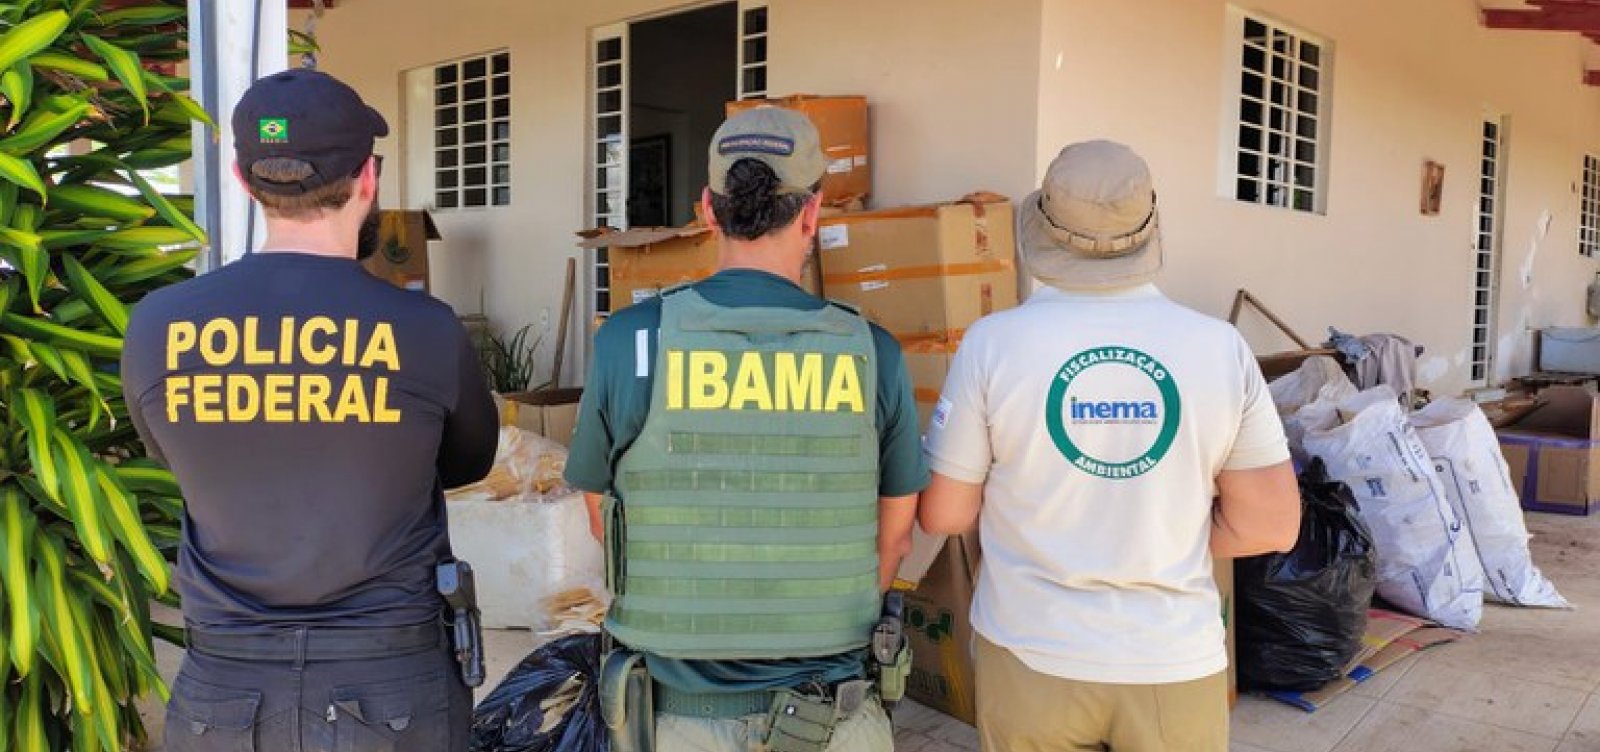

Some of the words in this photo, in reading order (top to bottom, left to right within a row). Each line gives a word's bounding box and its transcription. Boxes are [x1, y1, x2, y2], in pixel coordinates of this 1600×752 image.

[166, 316, 400, 370] POLICIA
[166, 374, 400, 422] FEDERAL
[666, 350, 865, 412] IBAMA
[1070, 396, 1158, 419] inema
[1075, 456, 1157, 477] AMBIENTAL
